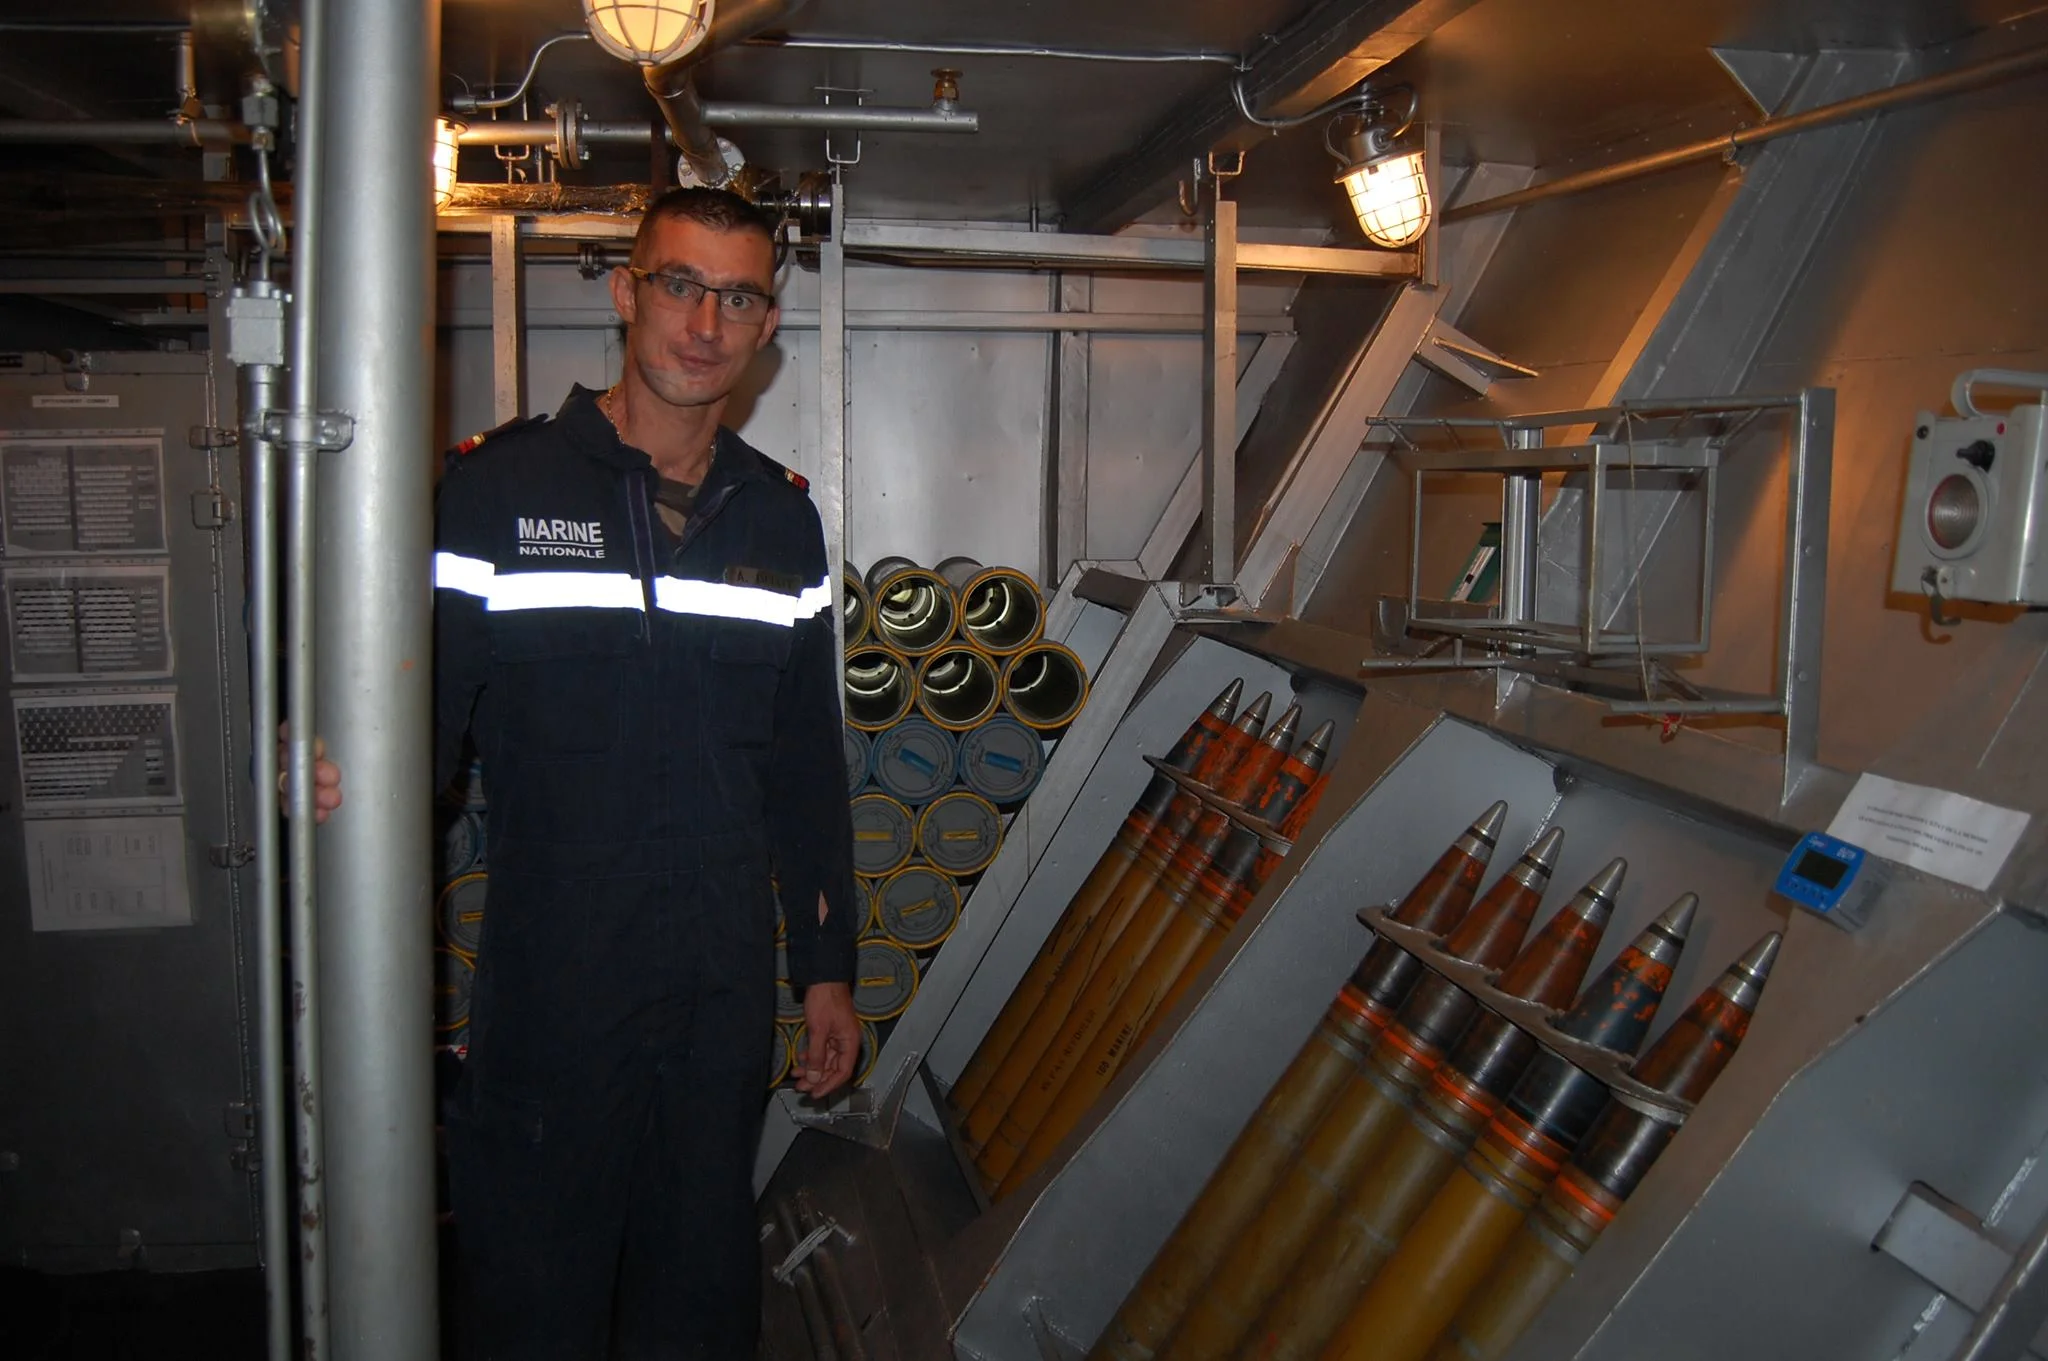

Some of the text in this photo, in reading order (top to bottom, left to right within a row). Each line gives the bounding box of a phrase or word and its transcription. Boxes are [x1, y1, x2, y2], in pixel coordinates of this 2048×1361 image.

[518, 517, 604, 543] MARINE
[519, 546, 606, 559] NATIONALE
[1108, 1022, 1133, 1058] MARINE
